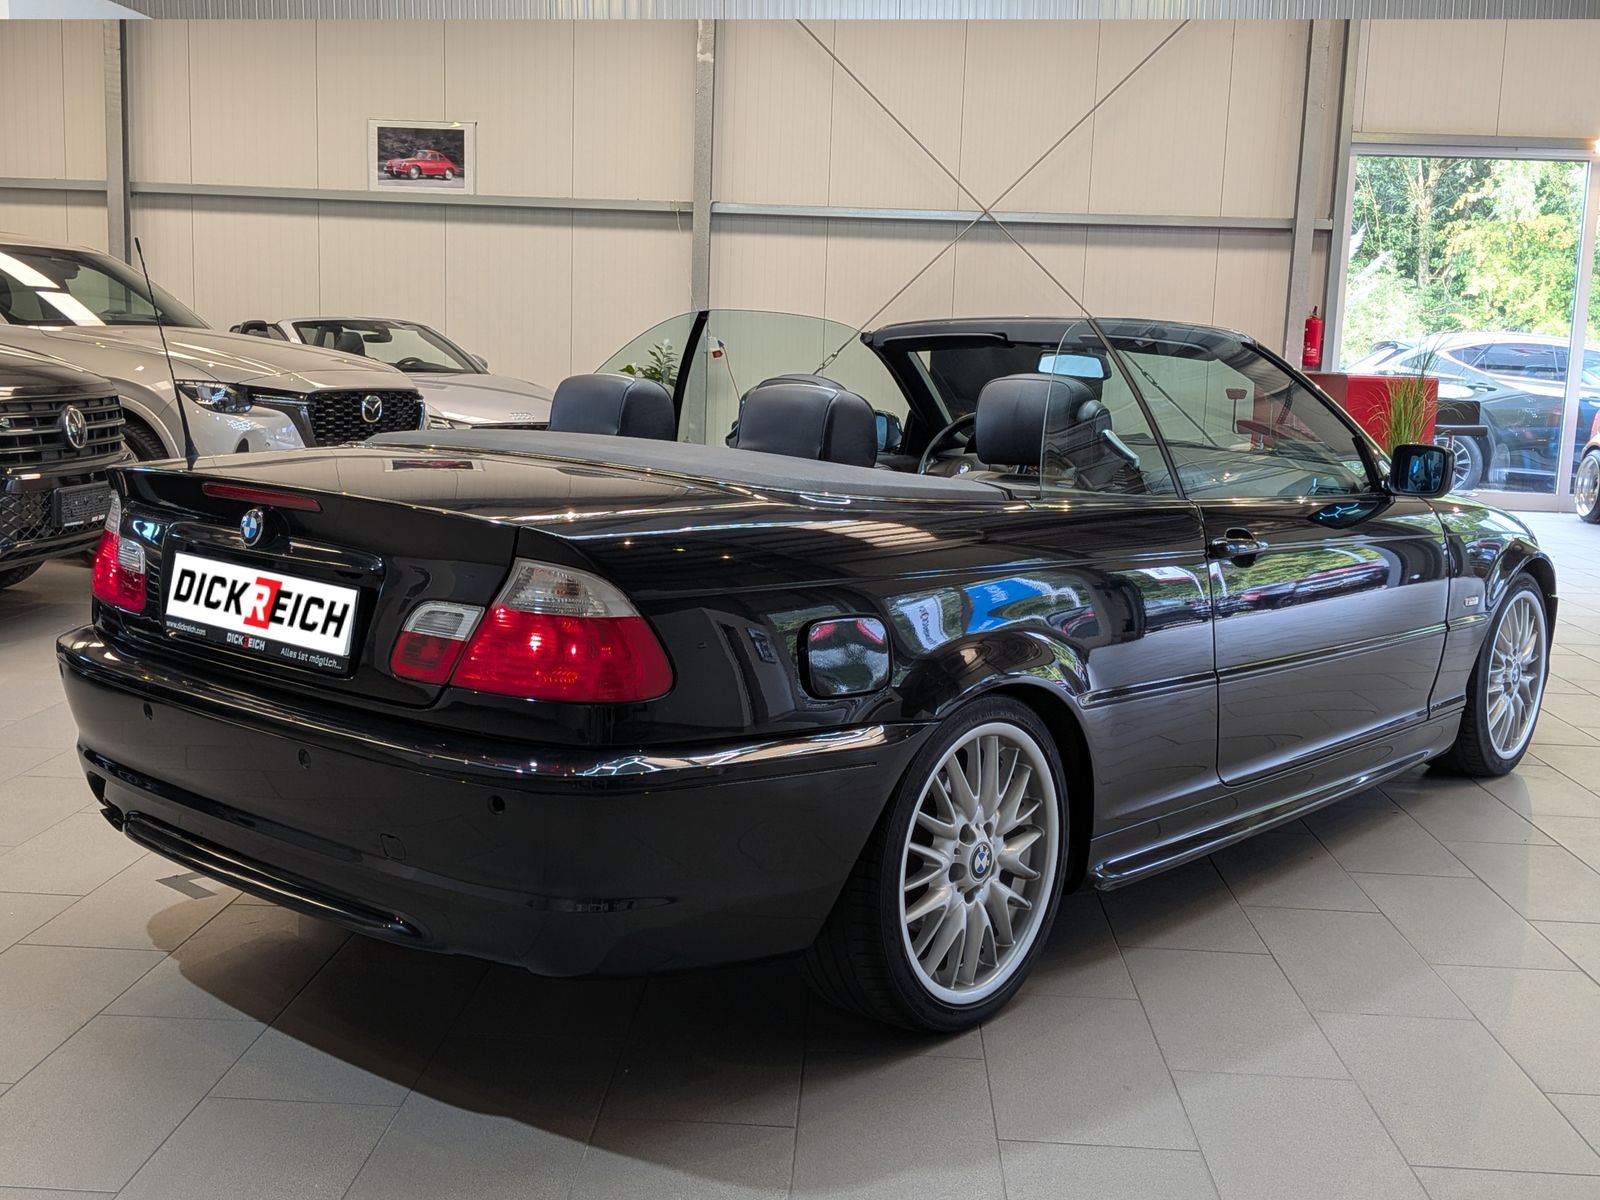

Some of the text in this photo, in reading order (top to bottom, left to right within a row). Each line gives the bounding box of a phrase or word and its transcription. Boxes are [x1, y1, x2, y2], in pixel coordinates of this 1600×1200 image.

[173, 568, 349, 638] DICKREICH
[226, 632, 266, 651] DICKREICH
[280, 647, 298, 660] Alles
[298, 650, 309, 662] ist
